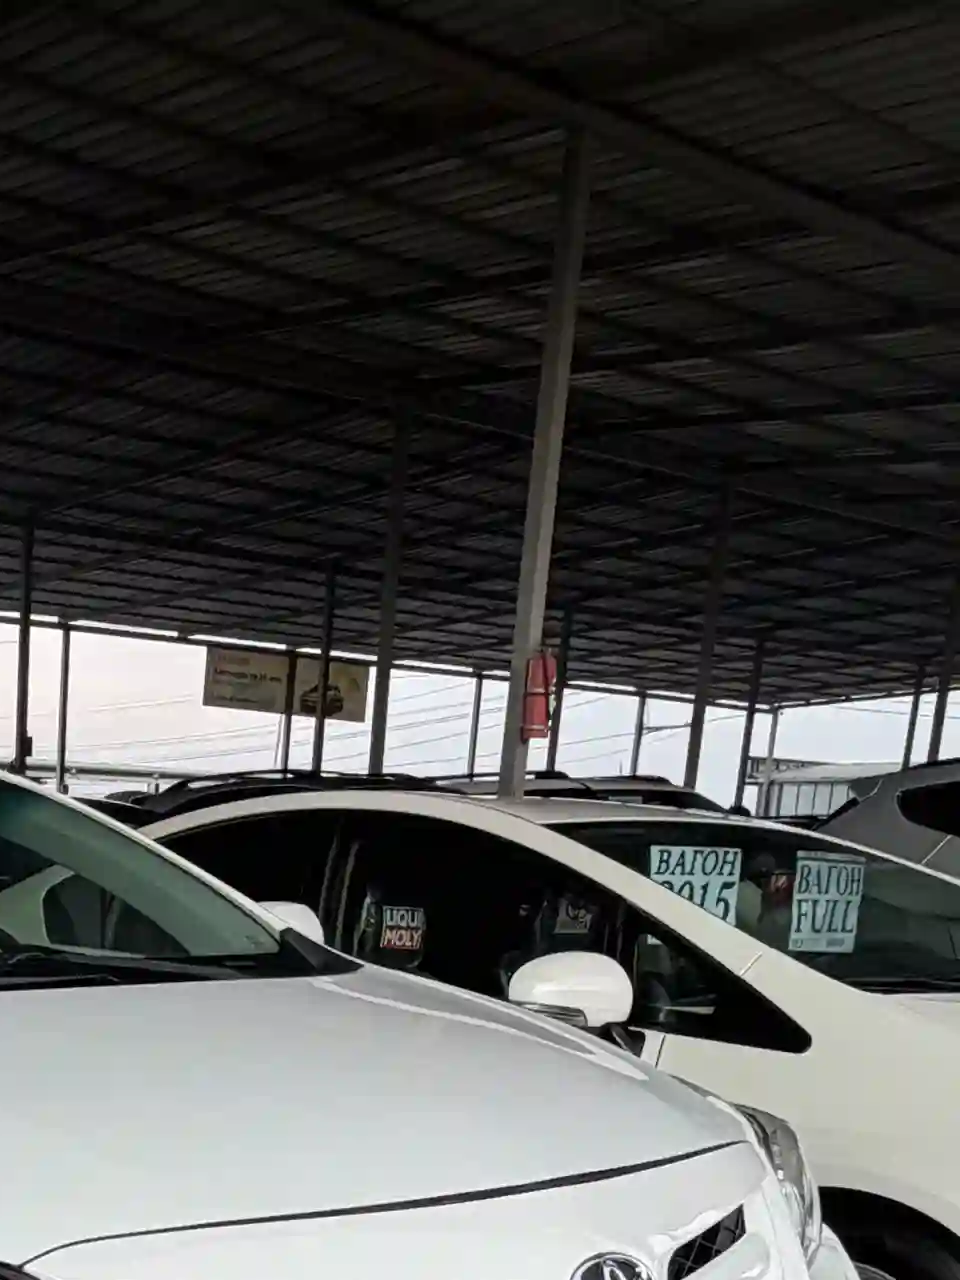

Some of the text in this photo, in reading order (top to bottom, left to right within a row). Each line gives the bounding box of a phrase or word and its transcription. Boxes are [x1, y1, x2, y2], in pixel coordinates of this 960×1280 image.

[654, 848, 740, 877] ВАГОН
[796, 863, 862, 897] ВАГОН
[656, 880, 737, 922] 15
[794, 899, 858, 934] FULL
